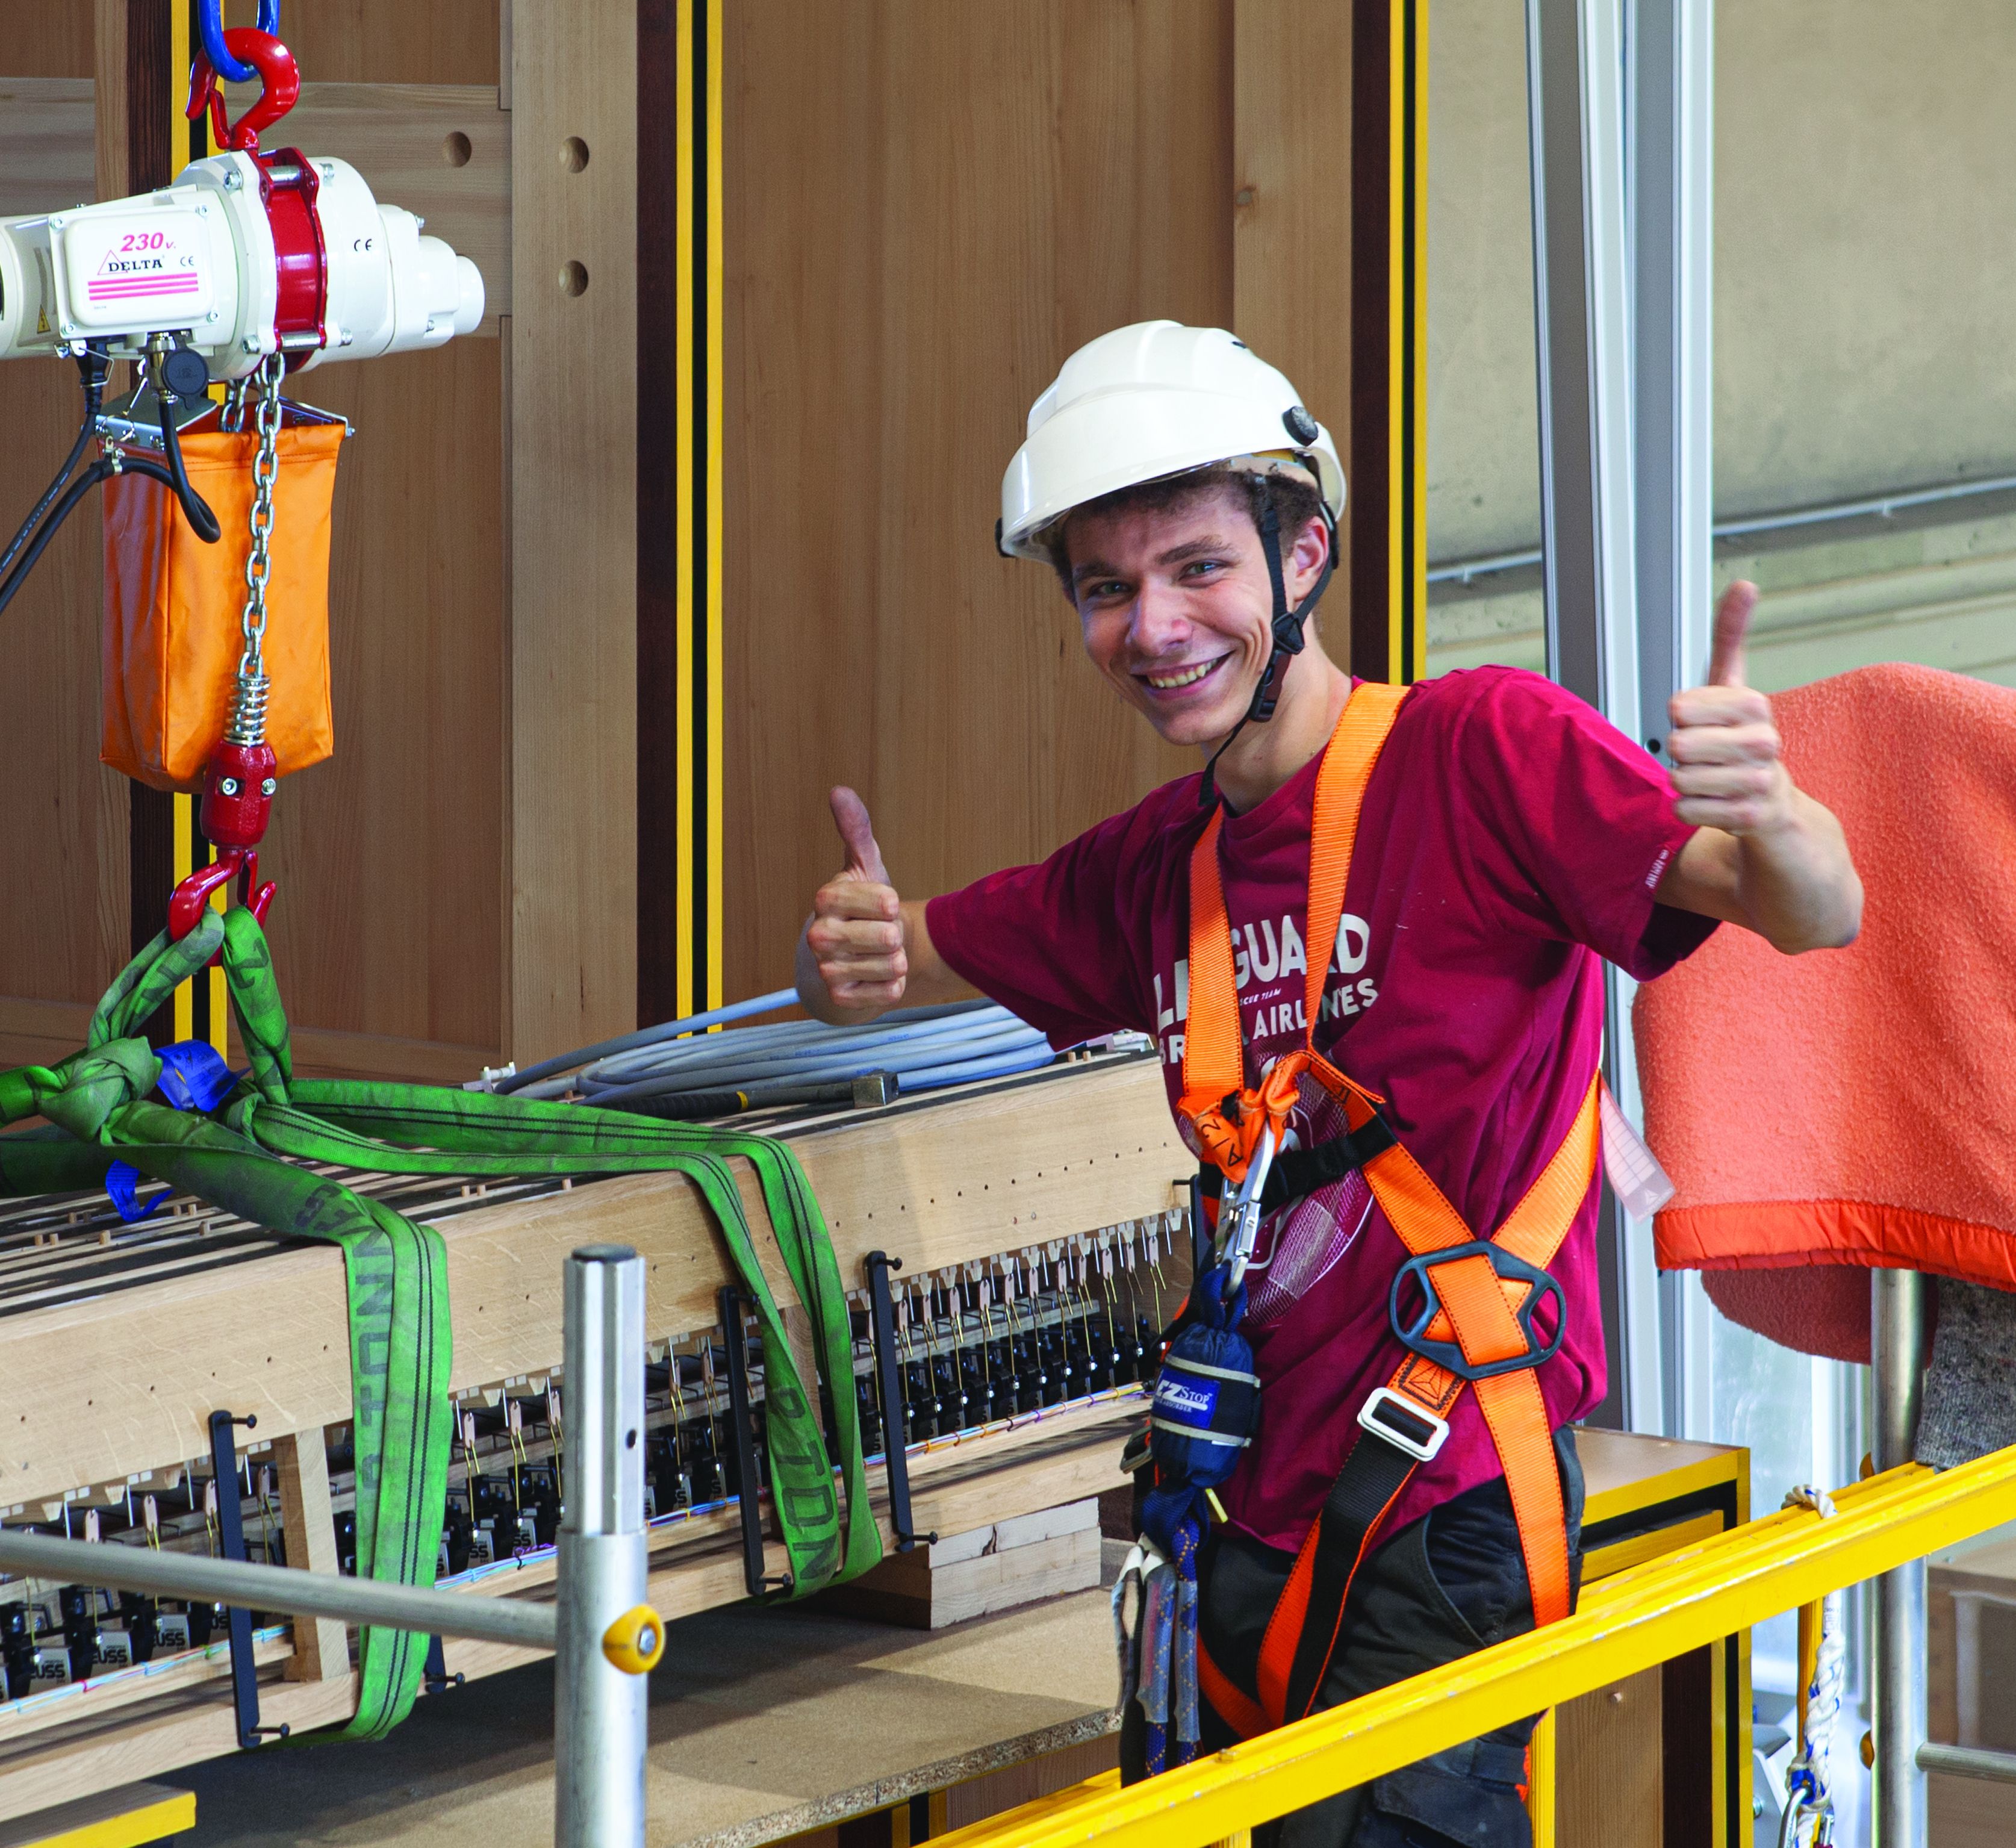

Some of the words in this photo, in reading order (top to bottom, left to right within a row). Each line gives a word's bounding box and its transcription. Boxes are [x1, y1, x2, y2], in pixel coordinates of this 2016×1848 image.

[120, 232, 164, 252] 230
[108, 259, 163, 272] DELTA
[1153, 913, 1371, 1035] LIGUAD
[1252, 978, 1379, 1041] AIRLNES
